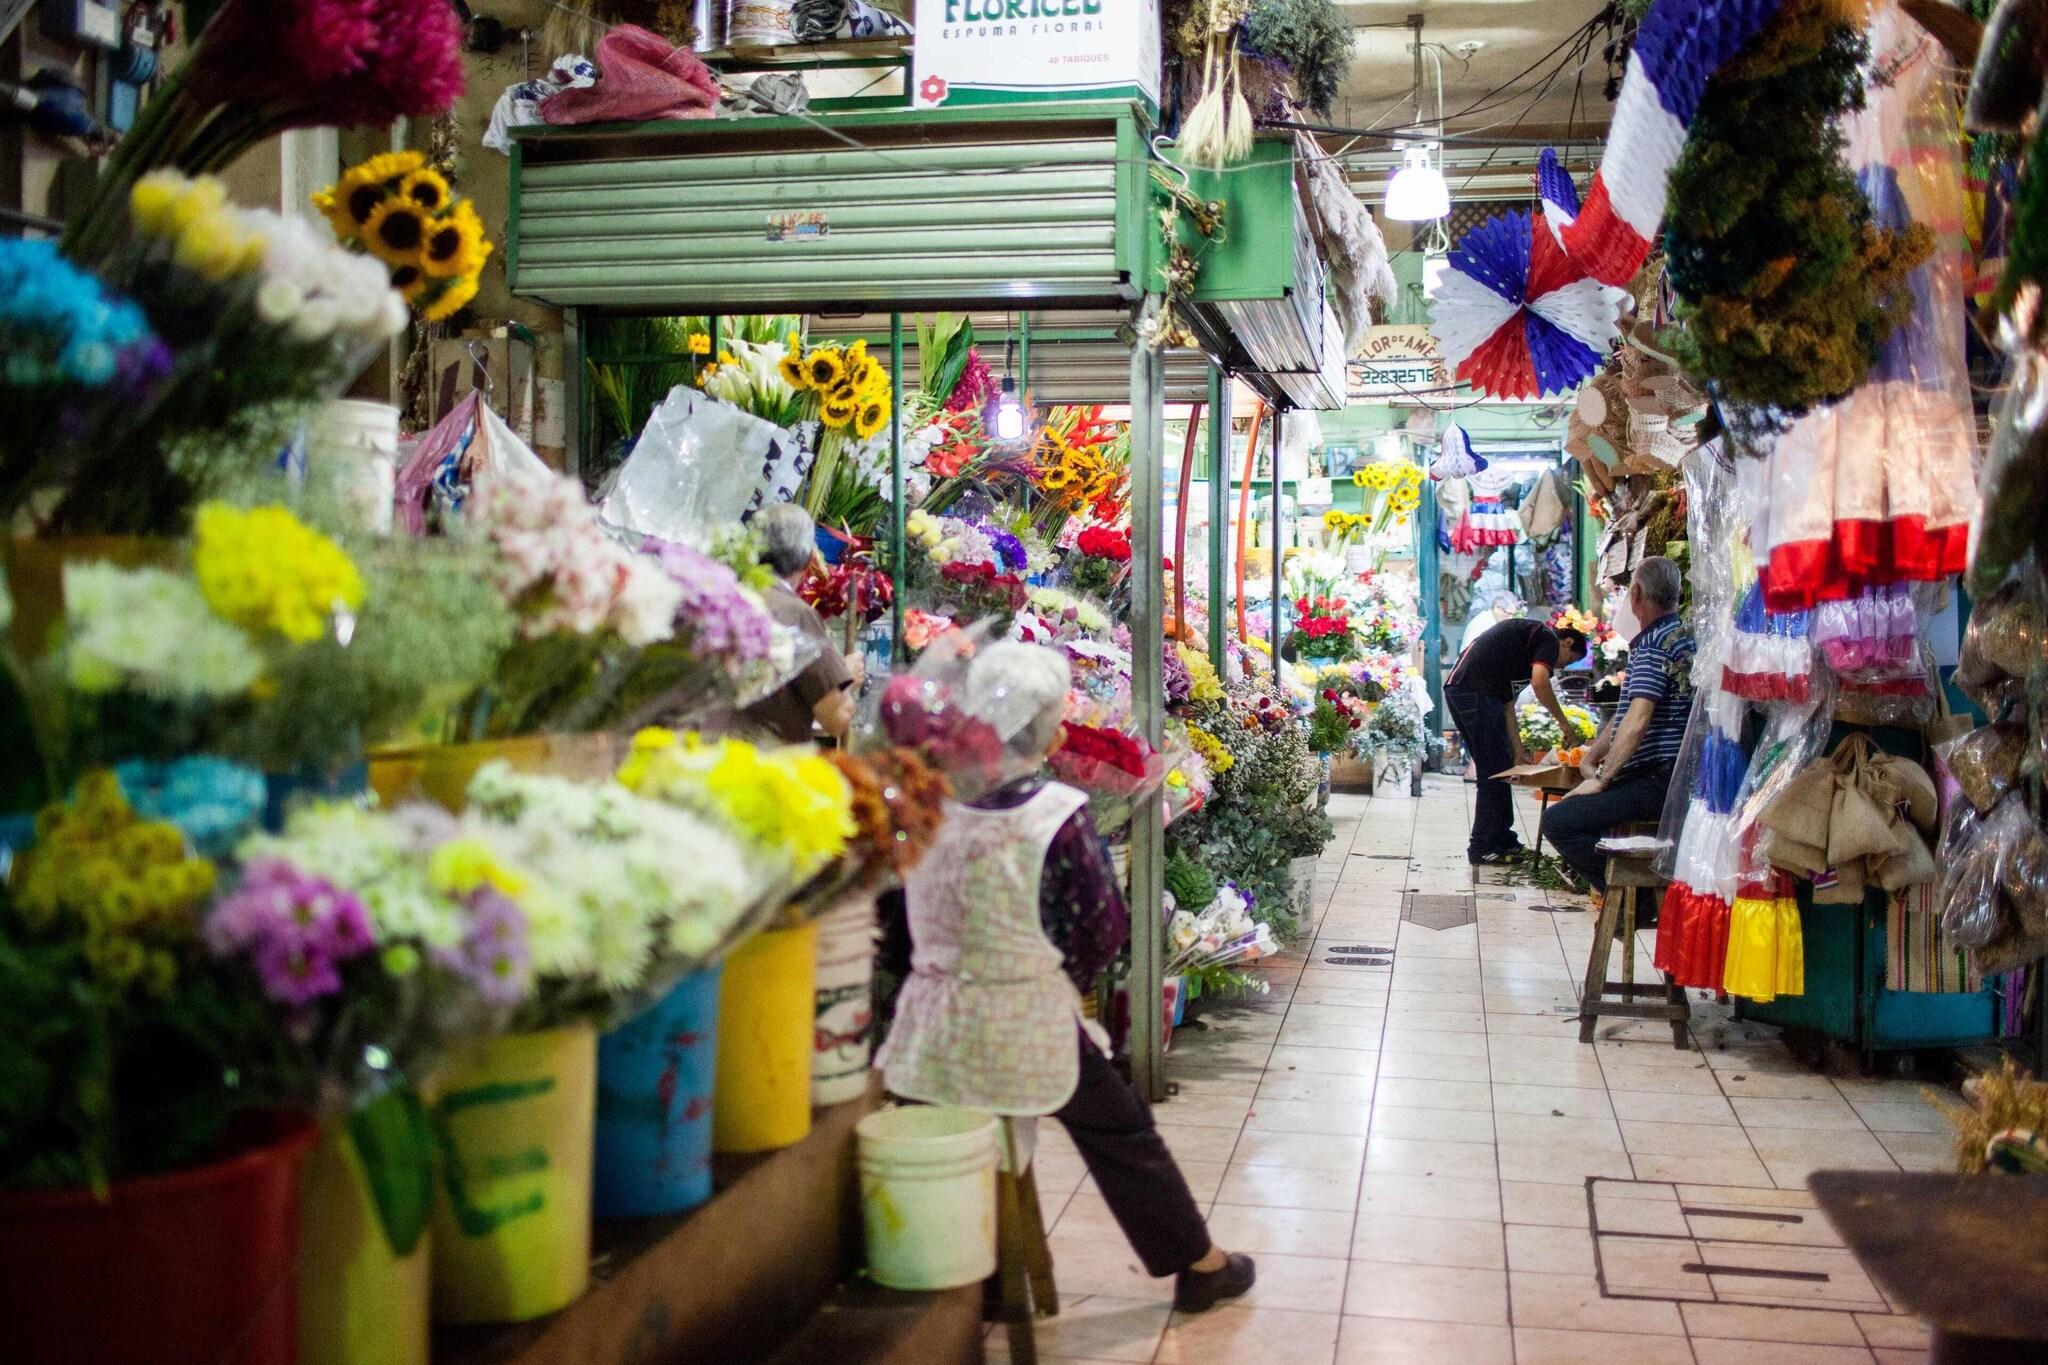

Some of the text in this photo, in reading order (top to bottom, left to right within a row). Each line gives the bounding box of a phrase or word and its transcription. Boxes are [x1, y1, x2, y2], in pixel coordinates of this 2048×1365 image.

[943, 21, 1102, 39] ESPUMA FLORAL
[1392, 335, 1405, 343] DE
